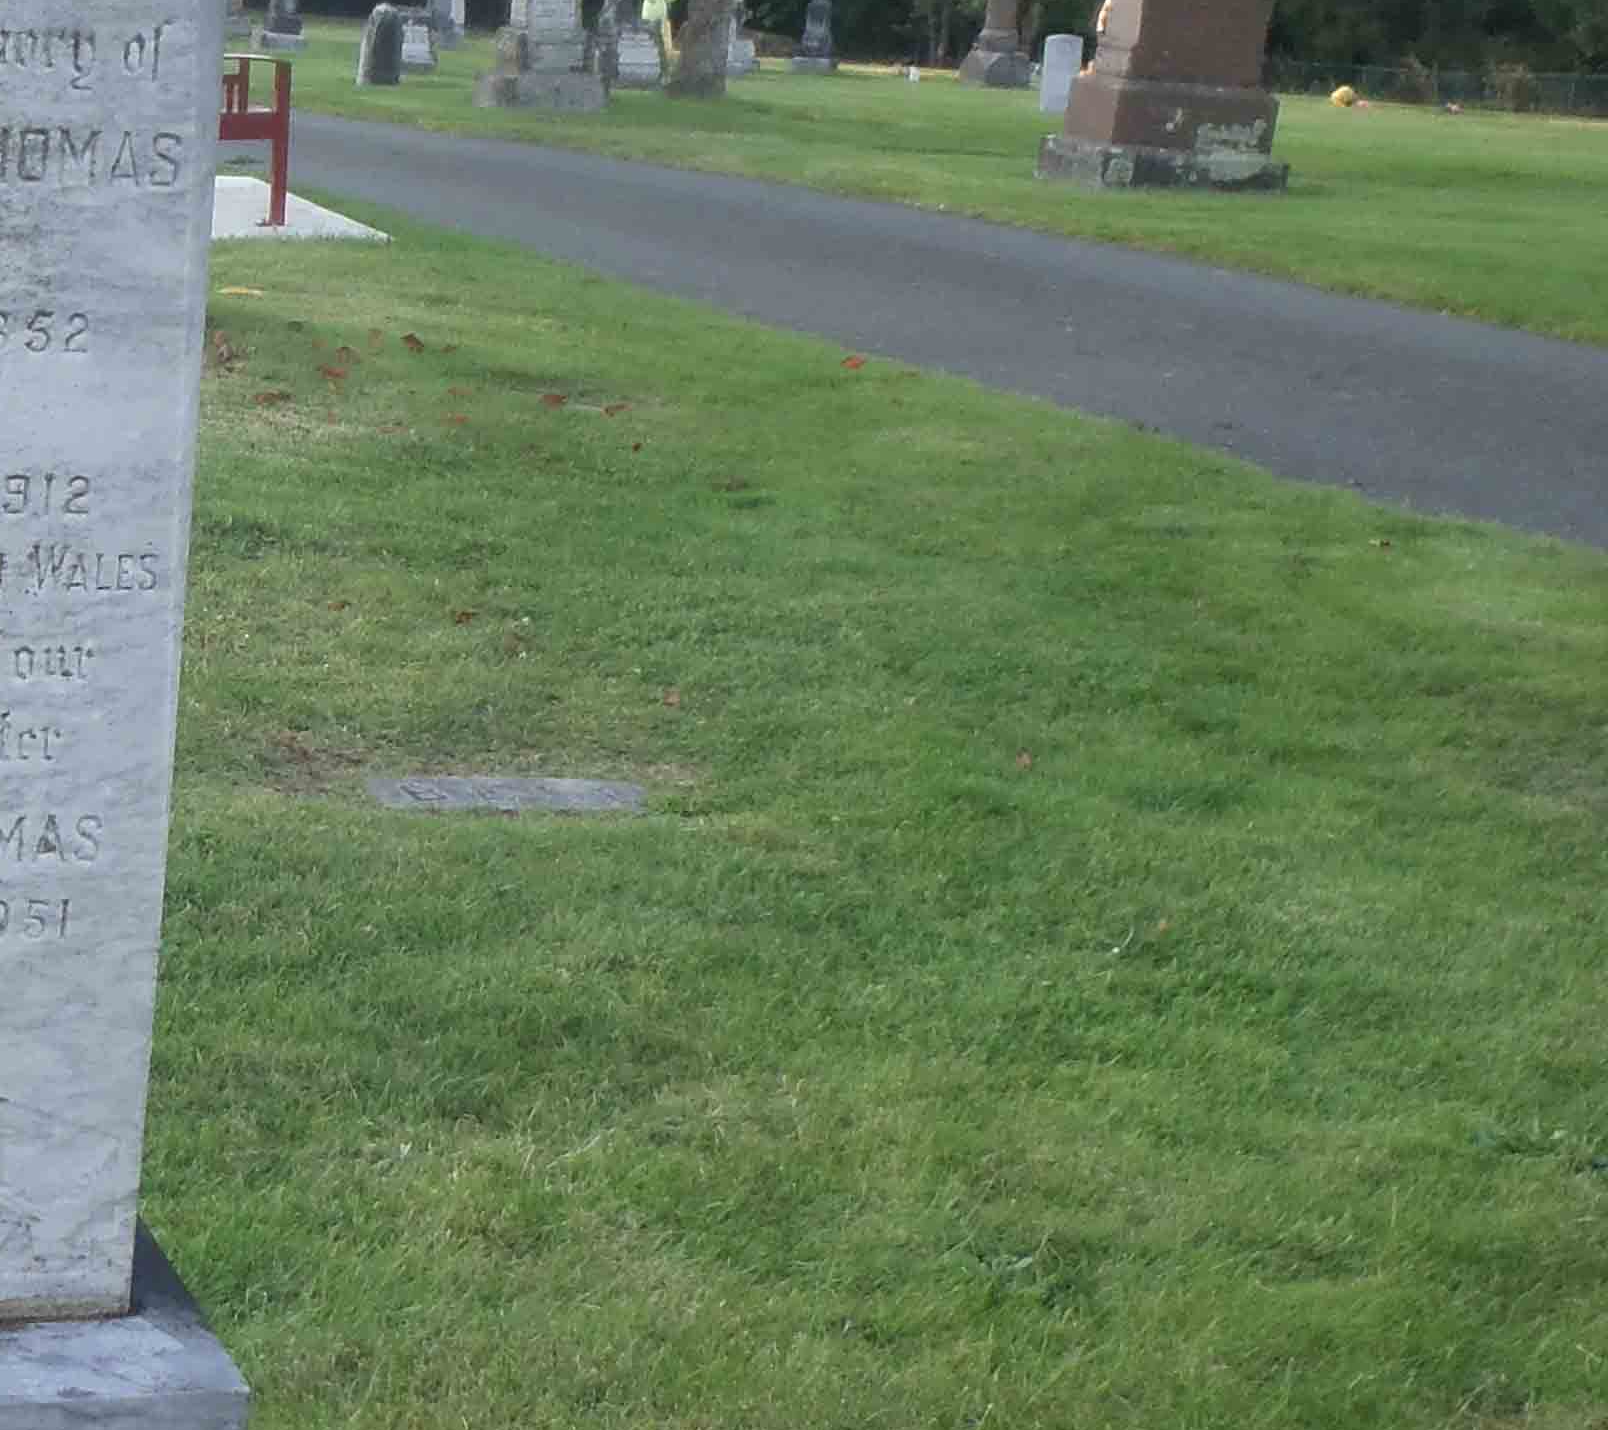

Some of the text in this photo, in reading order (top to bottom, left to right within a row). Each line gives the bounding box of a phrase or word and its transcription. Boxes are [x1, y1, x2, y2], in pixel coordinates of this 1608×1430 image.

[122, 17, 178, 83] of
[28, 543, 159, 593] WALES
[14, 644, 95, 681] our
